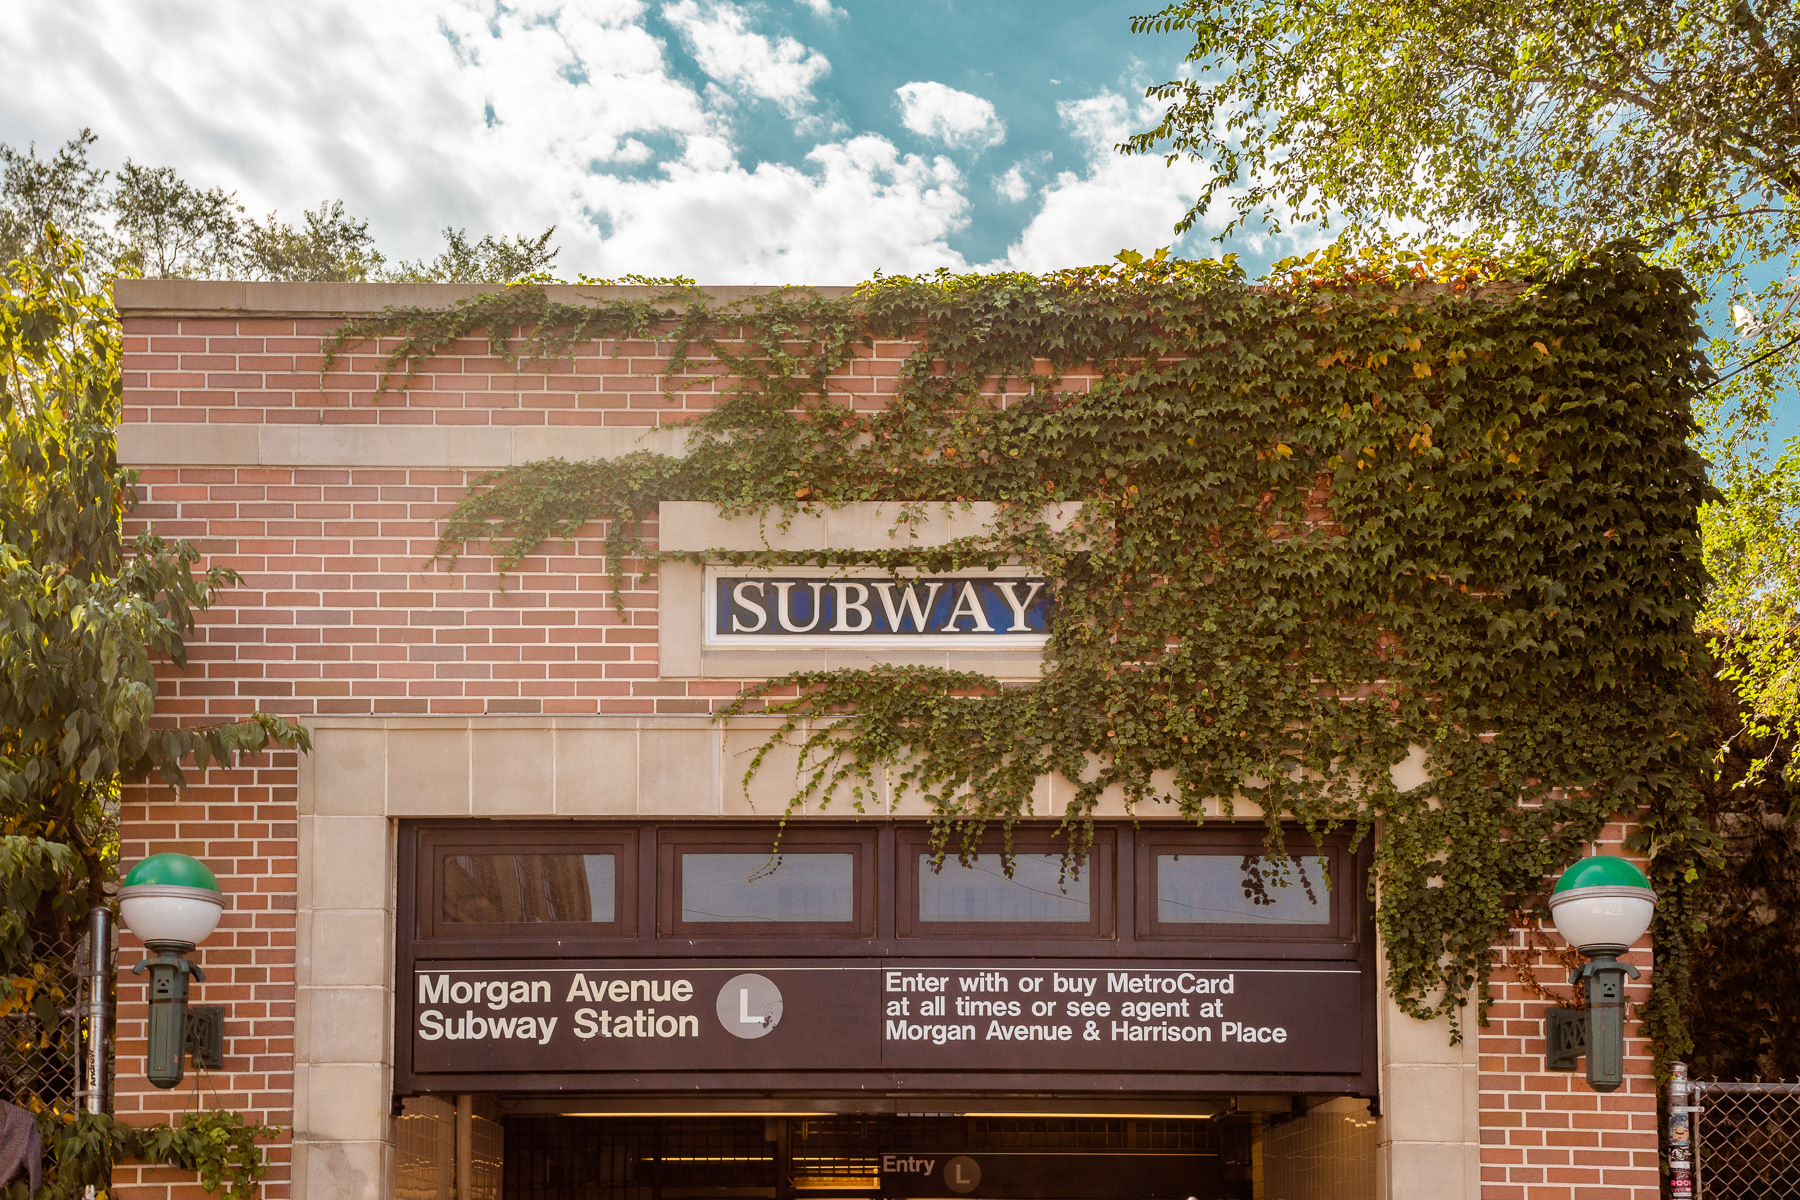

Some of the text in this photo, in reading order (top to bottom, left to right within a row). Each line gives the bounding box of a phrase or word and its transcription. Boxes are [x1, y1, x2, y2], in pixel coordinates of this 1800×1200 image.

[732, 580, 1045, 633] SUBWAY
[419, 973, 693, 1010] Morgan Avenue
[887, 972, 1234, 996] Enter with or buy MetroCard
[739, 988, 765, 1023] L
[887, 996, 1223, 1021] at all times or see agent at
[419, 1008, 698, 1044] Subway Station
[887, 1020, 1287, 1045] Morgan Avenue & Harrison Place
[883, 1155, 935, 1176] Entry
[955, 1163, 971, 1184] L
